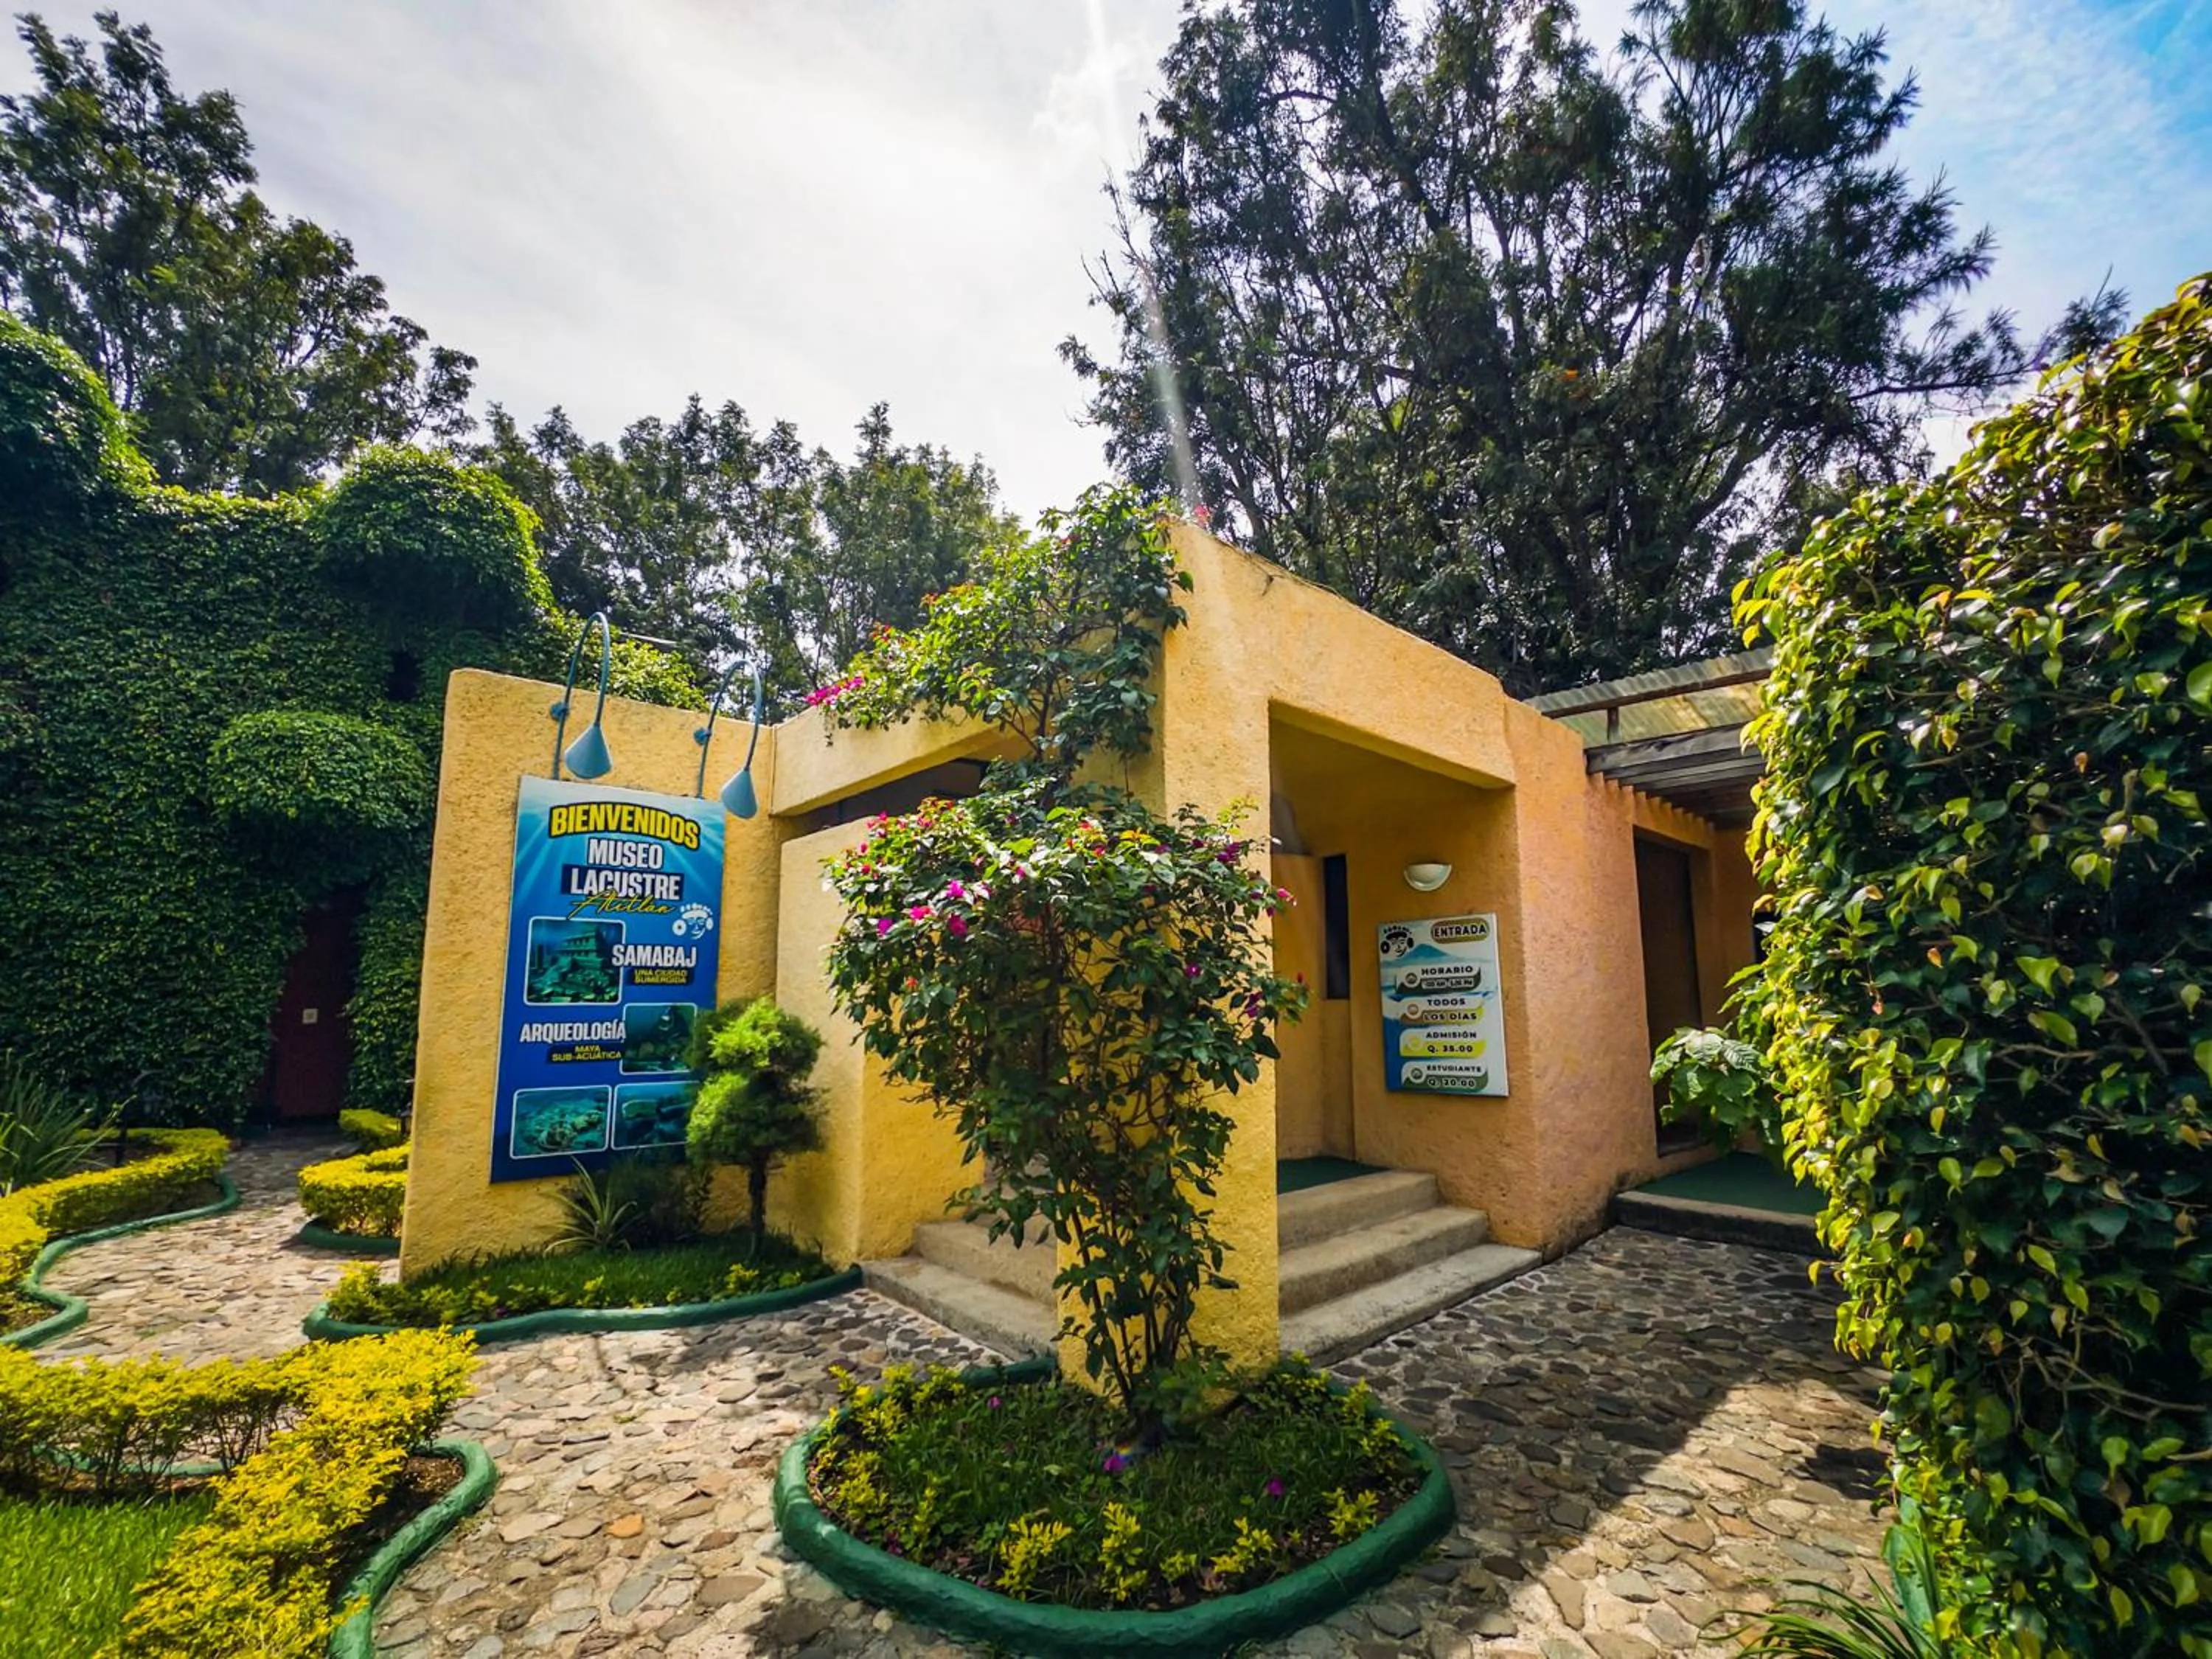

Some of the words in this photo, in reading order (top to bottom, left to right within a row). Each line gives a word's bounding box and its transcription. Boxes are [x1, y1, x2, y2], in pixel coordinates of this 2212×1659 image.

[550, 803, 700, 849] BIENVENIDOS
[588, 838, 663, 869] MUSEO
[570, 868, 681, 900] LACUSTRE
[1433, 923, 1487, 938] ENTRADA
[611, 944, 697, 967] SAMABAJ
[1421, 966, 1473, 975] HORARIO
[1427, 998, 1466, 1006] TODOS
[520, 1018, 627, 1044] ARQUEOLOGÍA
[1427, 1065, 1482, 1073] ESTUDIANTE
